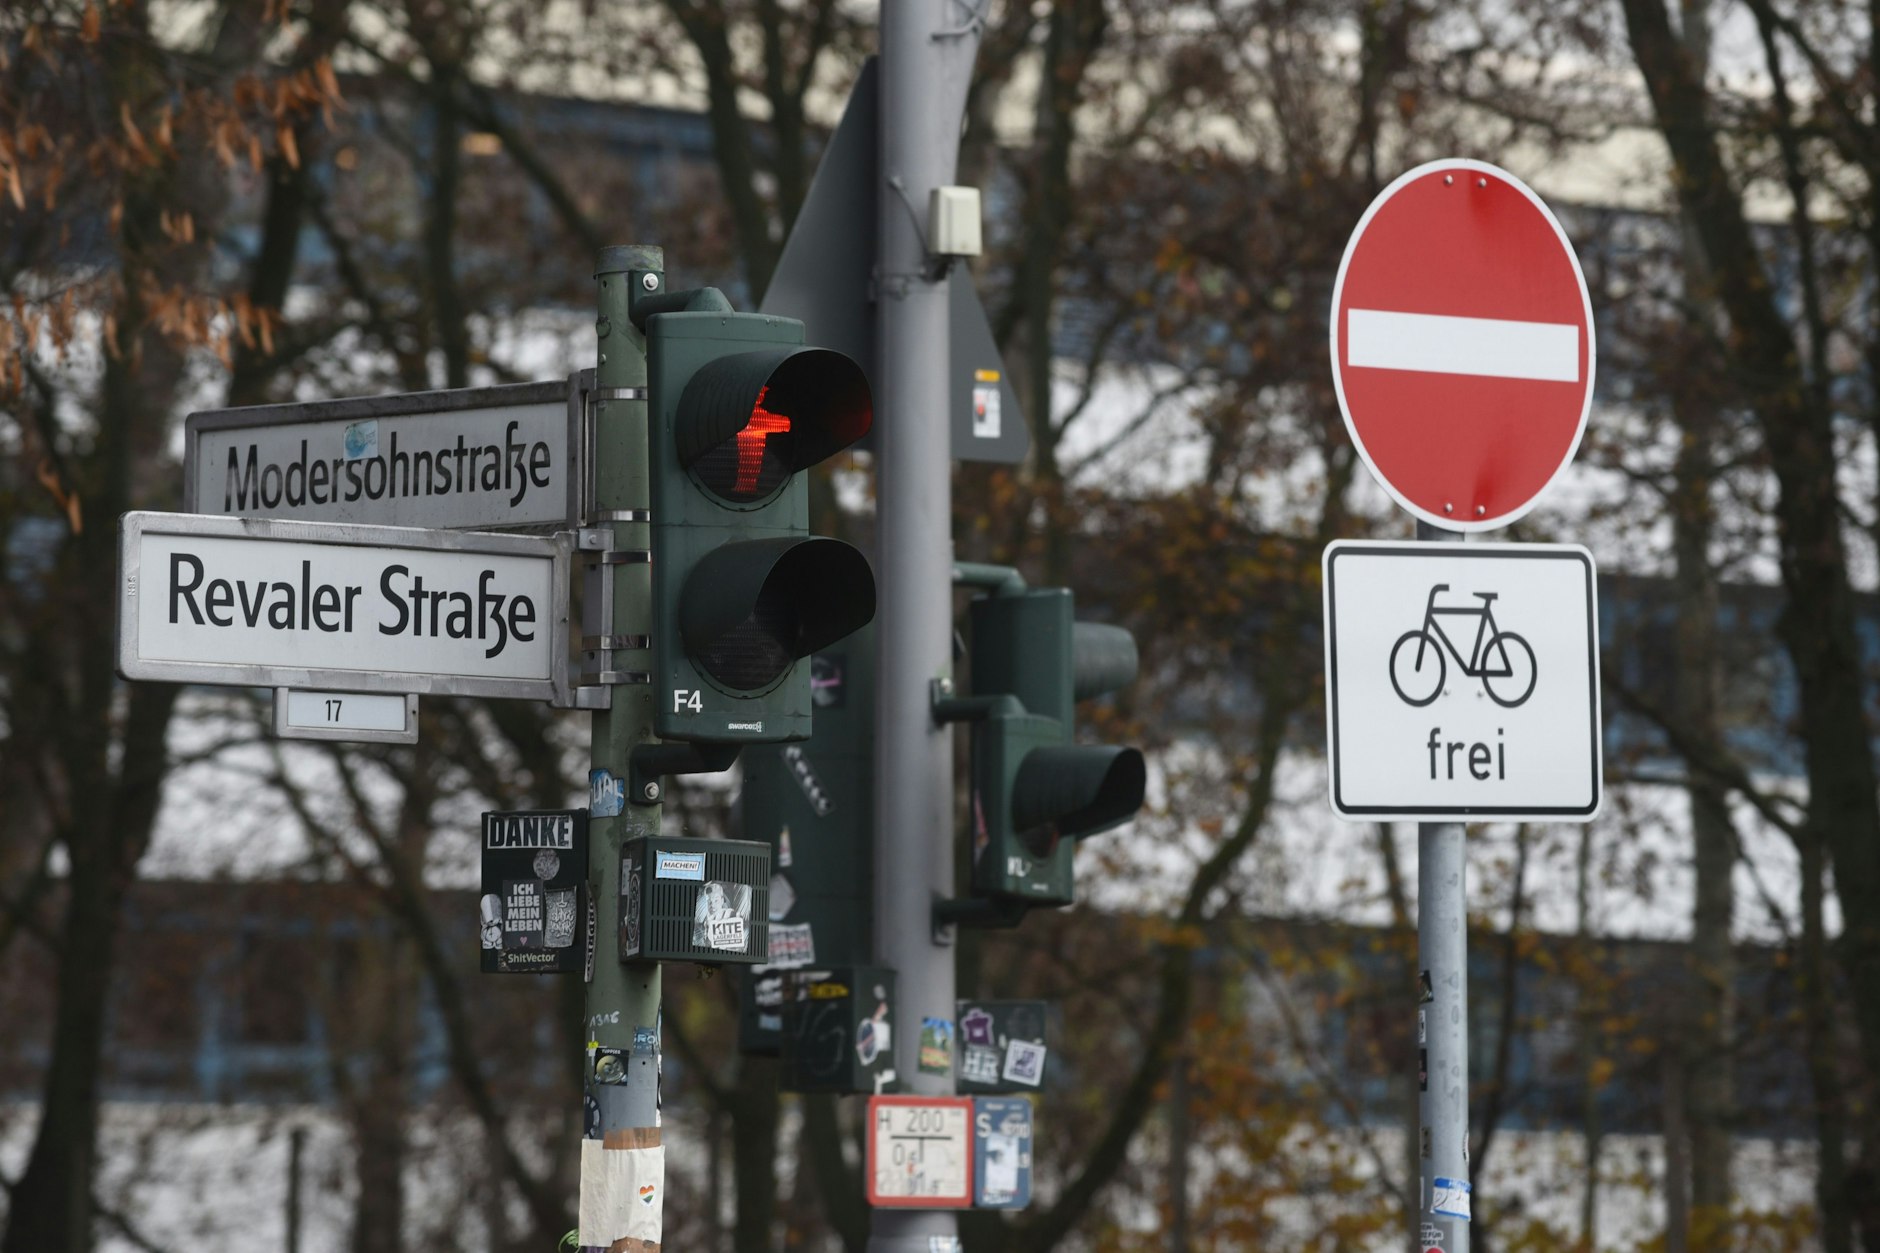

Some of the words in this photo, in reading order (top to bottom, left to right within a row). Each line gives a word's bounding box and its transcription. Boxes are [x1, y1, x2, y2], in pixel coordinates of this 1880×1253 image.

[224, 421, 551, 512] Modersohnstraße
[168, 552, 362, 633] Revaler
[378, 564, 536, 659] Straße
[673, 689, 703, 713] F4
[325, 699, 343, 722] 17
[1427, 727, 1505, 781] frei
[489, 816, 570, 847] DANKE
[663, 861, 698, 869] MACHEN!
[513, 883, 534, 895] ICH
[507, 895, 540, 908] LIEBE
[507, 907, 540, 919] MEIN
[505, 920, 542, 932] LEBEN
[712, 922, 742, 935] KITE
[508, 953, 555, 963] ShitVector
[877, 1110, 892, 1131] H
[906, 1108, 944, 1132] 200
